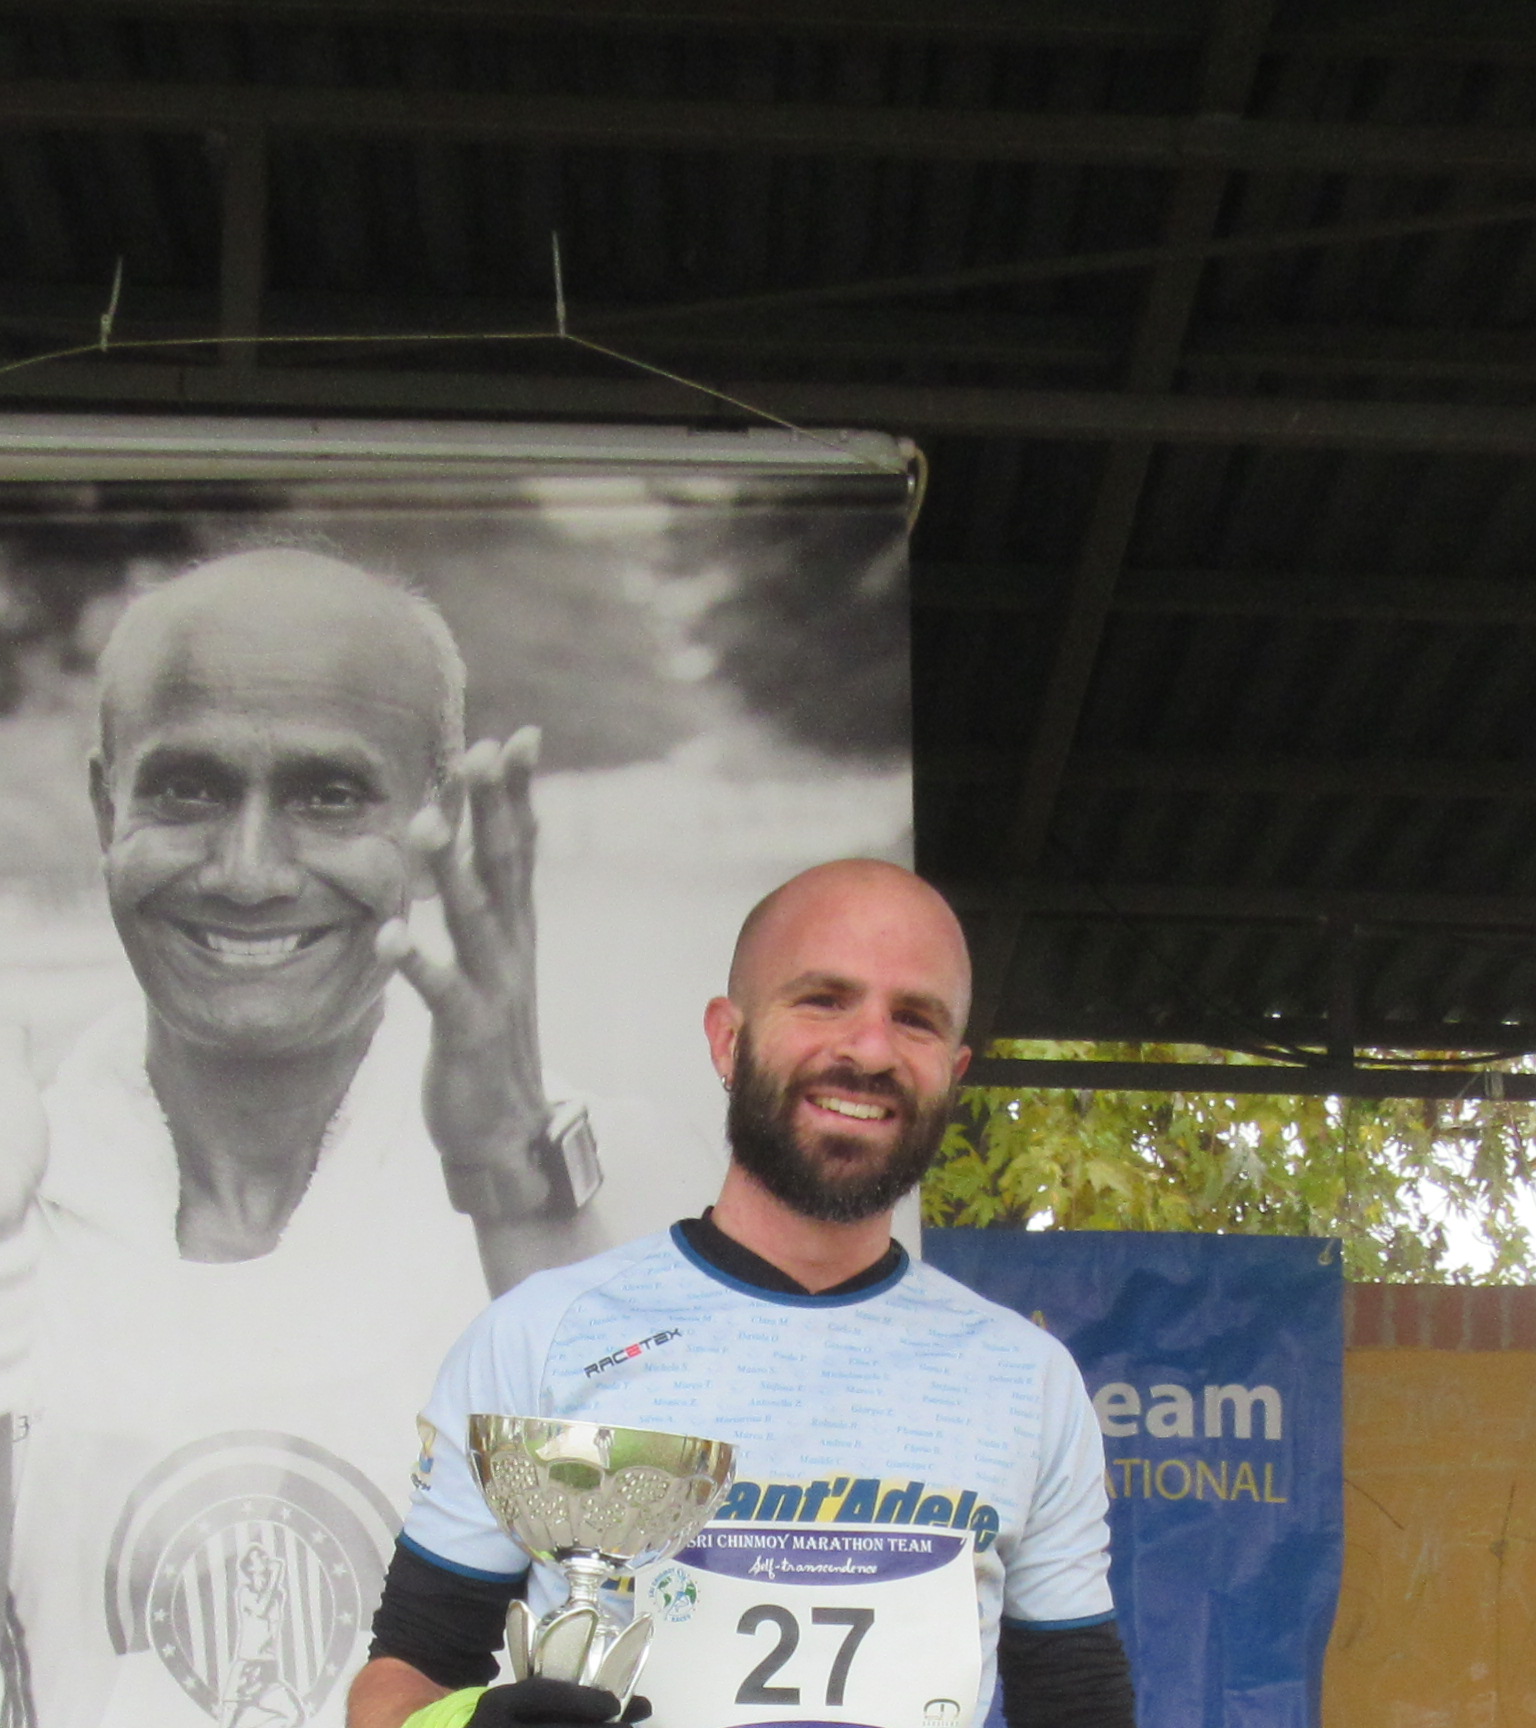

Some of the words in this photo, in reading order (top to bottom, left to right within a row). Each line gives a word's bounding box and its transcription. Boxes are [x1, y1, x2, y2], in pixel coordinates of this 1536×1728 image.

[686, 1533, 714, 1549] SRI
[716, 1532, 791, 1550] CHINMOY
[792, 1535, 885, 1552] MARATHON
[888, 1537, 933, 1554] TEAM
[733, 1603, 876, 1708] 27
